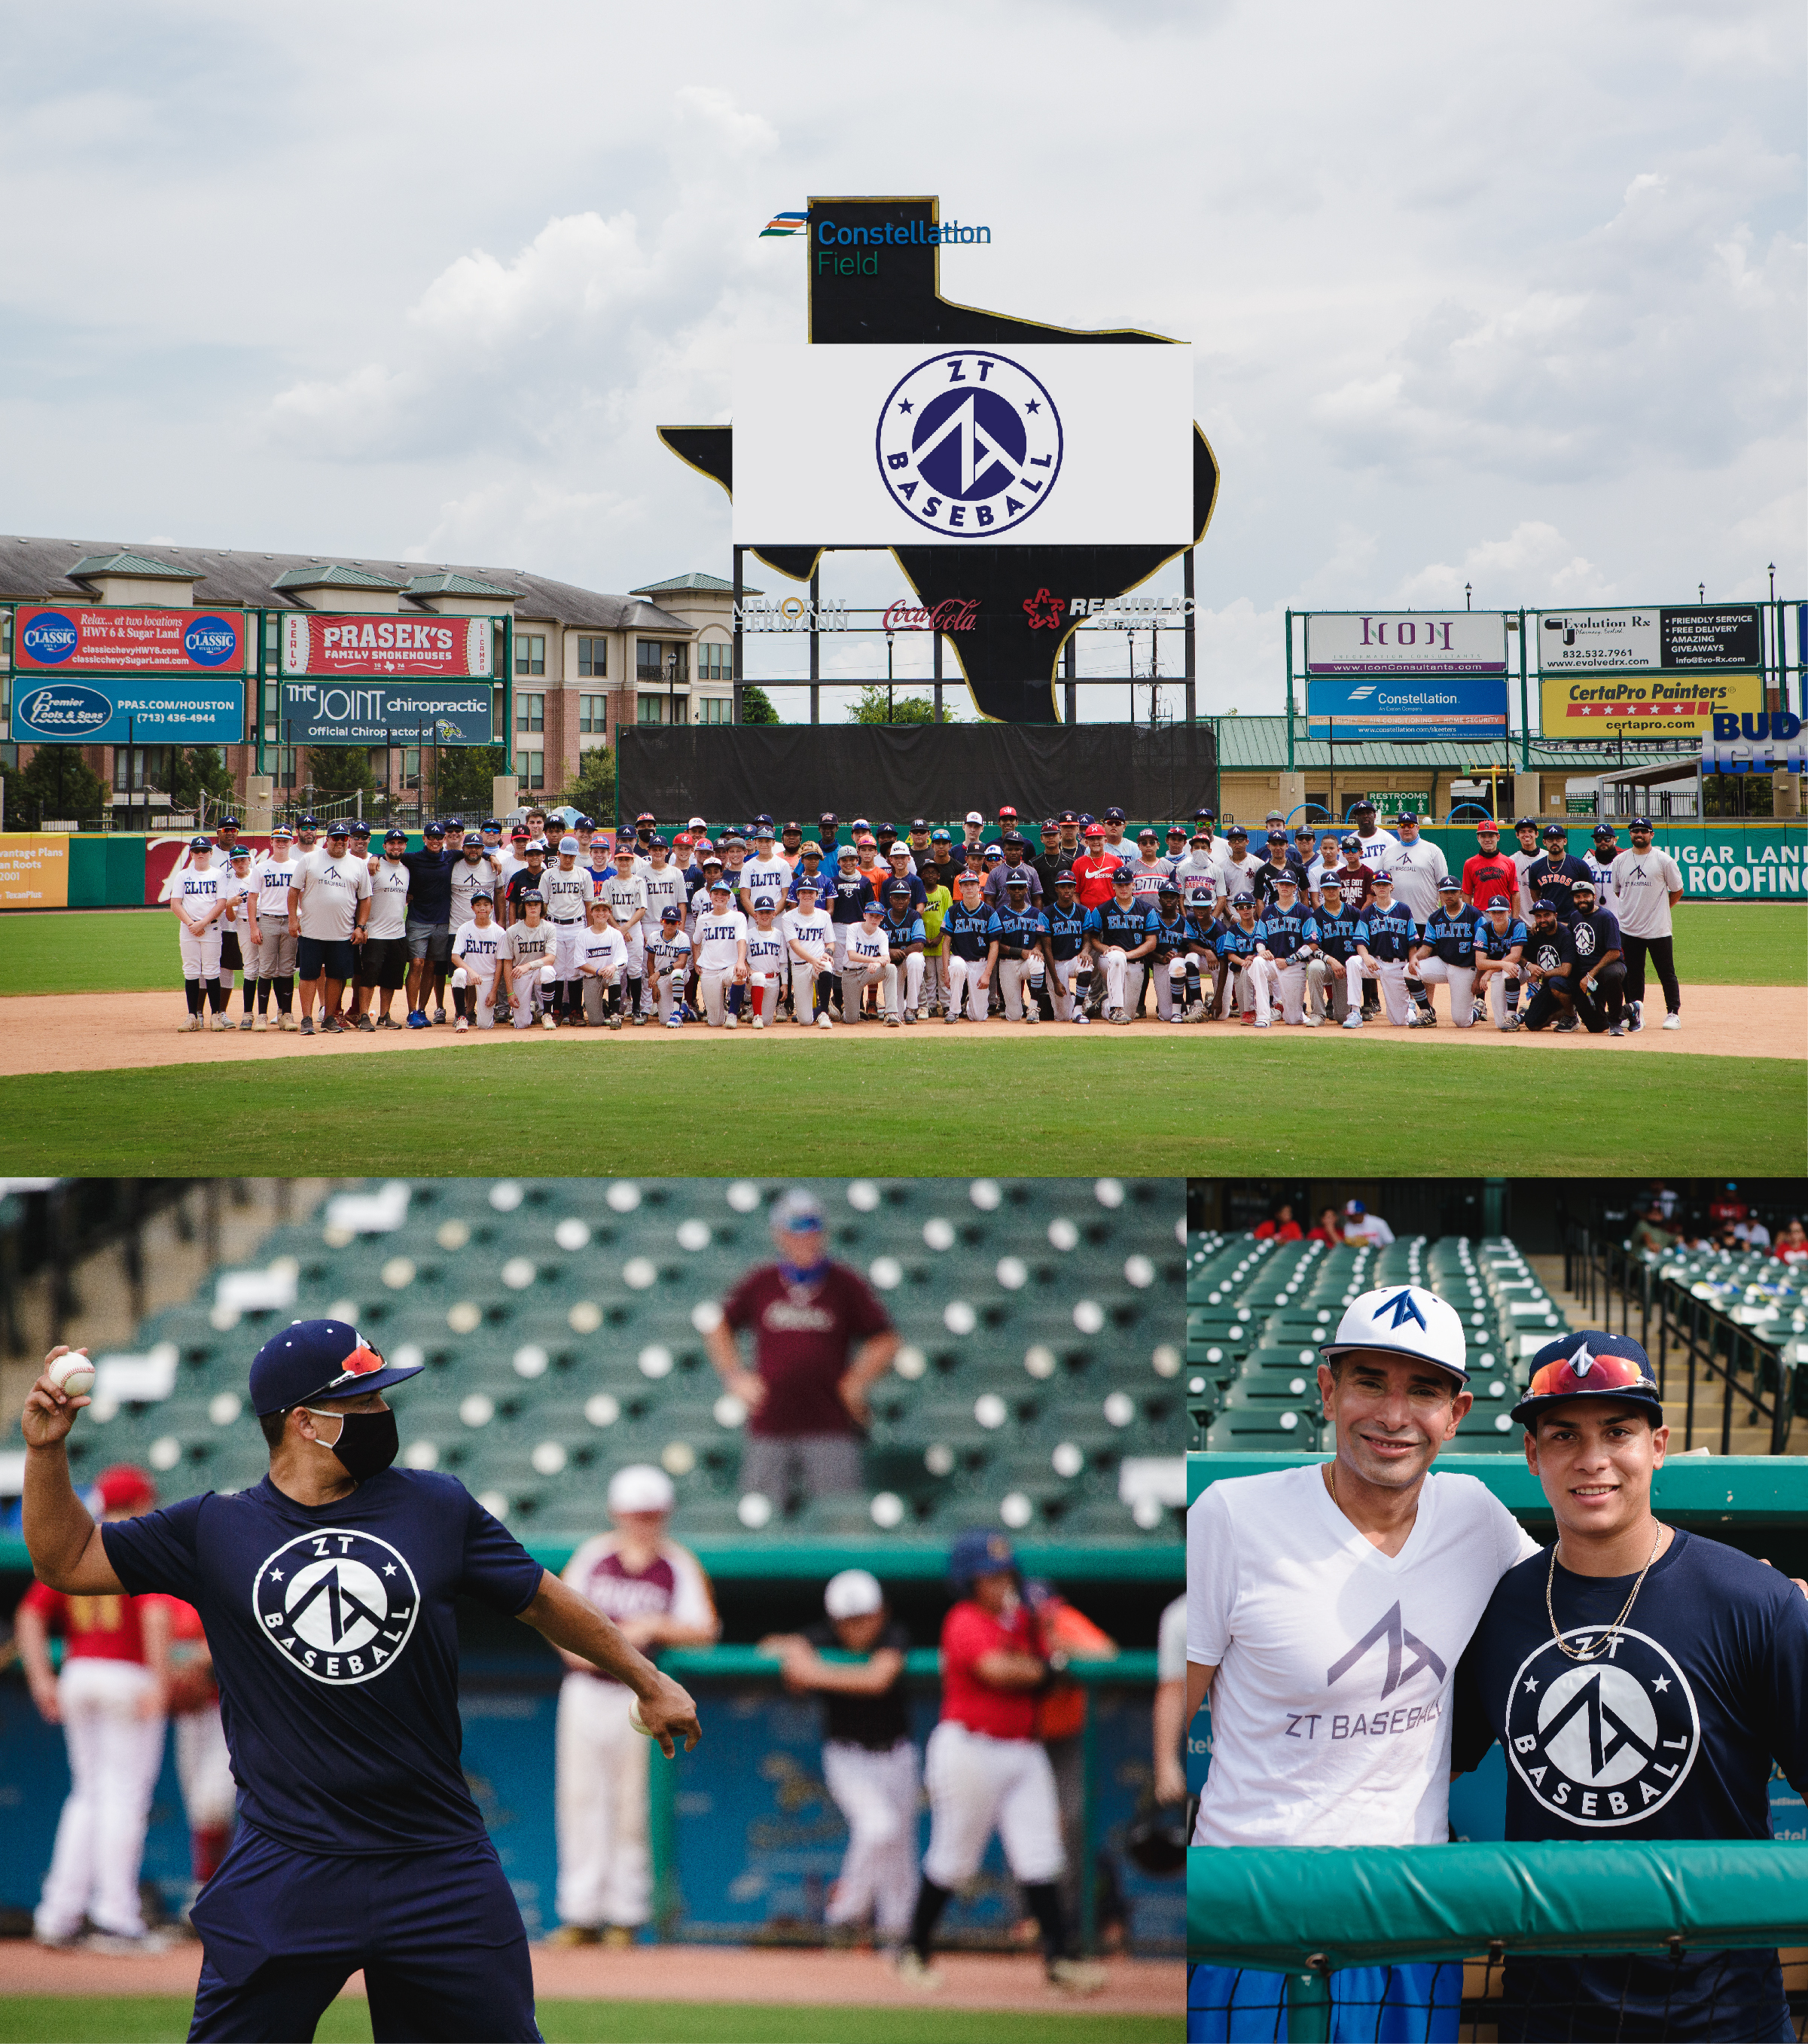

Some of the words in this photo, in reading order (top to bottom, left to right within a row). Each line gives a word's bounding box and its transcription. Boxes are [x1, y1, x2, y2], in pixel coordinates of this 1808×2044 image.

[819, 220, 991, 245] Constellation
[819, 252, 878, 275] Field
[947, 359, 994, 382] ZT
[887, 452, 1052, 526] BASEBALL
[731, 598, 847, 618] MEMORIAL
[1069, 598, 1196, 616] REPUBLIC
[81, 614, 112, 625] Relax...
[114, 616, 124, 625] at
[126, 616, 142, 626] two
[144, 615, 182, 627] locations
[730, 615, 849, 632] HERMANN
[1096, 618, 1167, 630] SERVICES
[1564, 617, 1626, 629] Evolution
[1632, 616, 1651, 627] Rx
[1671, 617, 1713, 625] FRIENDLY
[82, 627, 108, 637] HWY
[109, 627, 116, 637] 6
[117, 627, 126, 638] &
[127, 627, 154, 640] Sugar
[156, 628, 179, 639] Land
[324, 623, 453, 649] PRASEK'S
[480, 624, 484, 636] EL
[1695, 625, 1738, 633] DELIVERY
[24, 630, 75, 646] CLASSIC
[185, 634, 233, 649] CLASSIC
[82, 645, 179, 655] classicchevyHWY6.com
[325, 650, 369, 660] FAMILY
[371, 650, 452, 660] SMOKEHOUSES
[1563, 649, 1633, 658] 832.532.7961
[1671, 645, 1724, 653] GIVEAWAYS
[72, 655, 189, 666] classicchevySugarLand.com
[1547, 658, 1649, 667] www.evolvedrx.com
[1675, 656, 1745, 664] info@Evo-Rx.com
[286, 685, 316, 702] THE
[1569, 684, 1647, 701] CertaPro
[1651, 682, 1727, 699] Painters
[34, 691, 84, 709] Premier
[117, 700, 234, 709] PPAS.COM/HOUSTON
[313, 689, 386, 720] JOINT
[387, 697, 486, 714] chiropractic
[32, 703, 64, 723] Pools
[78, 711, 103, 721] Spas
[137, 713, 165, 723] (713)
[167, 714, 215, 723] 436-4944
[308, 727, 348, 737] Official
[422, 728, 433, 736] of
[1606, 720, 1695, 731] certapro.com
[1713, 712, 1800, 740] BUD
[1702, 746, 1774, 773] ICE
[38, 847, 63, 857] Plans
[13, 860, 41, 869] Roots
[0, 872, 20, 881] 2001
[264, 874, 293, 887] ELIT
[751, 873, 781, 887] ELITE
[5, 891, 42, 899] TexanPlus
[551, 883, 580, 894] ELITE
[648, 883, 674, 895] ELITE
[954, 918, 987, 933] ELITE
[1002, 917, 1038, 933] ELITE
[1267, 917, 1301, 935] ELITE
[1369, 917, 1407, 935] ELITE
[703, 926, 735, 941] ELITE
[1024, 935, 1029, 944] 2
[518, 941, 545, 953] ELITE
[1289, 936, 1295, 948] 3
[313, 1536, 353, 1556] ZT
[264, 1607, 410, 1676] BASEBALL
[1575, 1637, 1624, 1659] ZT
[1285, 1713, 1322, 1739] ZT
[1332, 1697, 1443, 1739] BASEBALL
[1514, 1734, 1687, 1816] BASEBALL
